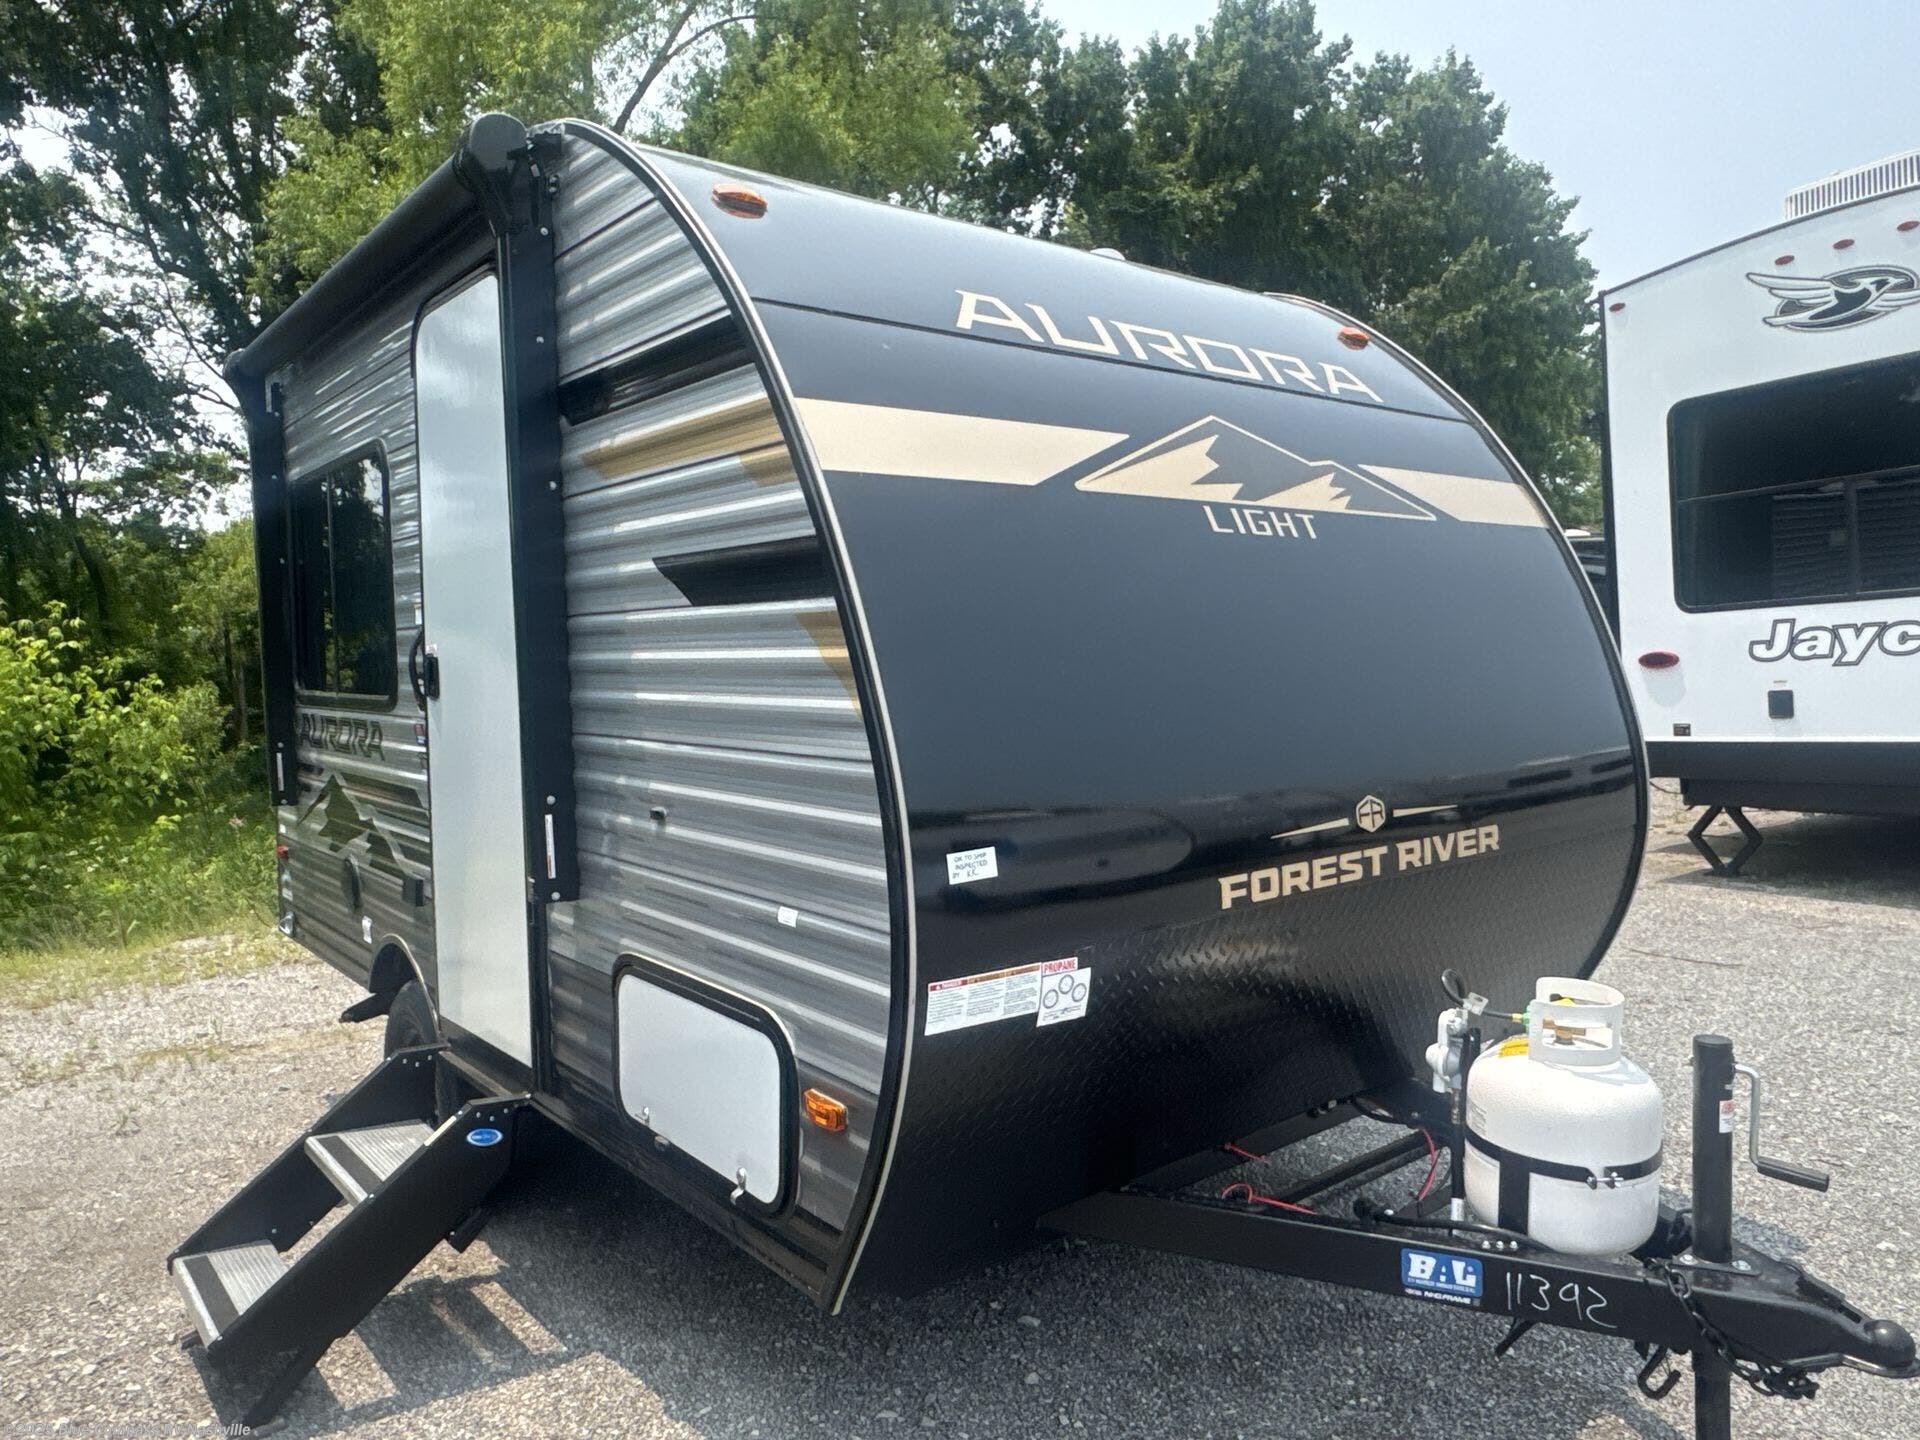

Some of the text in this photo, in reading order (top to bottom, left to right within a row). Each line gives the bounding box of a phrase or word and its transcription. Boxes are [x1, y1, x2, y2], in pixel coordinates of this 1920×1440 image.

[955, 290, 1384, 402] AURORA
[1203, 504, 1318, 540] LIGHT
[1749, 618, 1920, 667] Jayc
[301, 713, 386, 761] AURORA
[1218, 824, 1500, 910] FOREST RIVER
[1044, 959, 1076, 974] PROPANE
[1408, 1253, 1476, 1288] BAL
[1506, 1271, 1618, 1329] 11392
